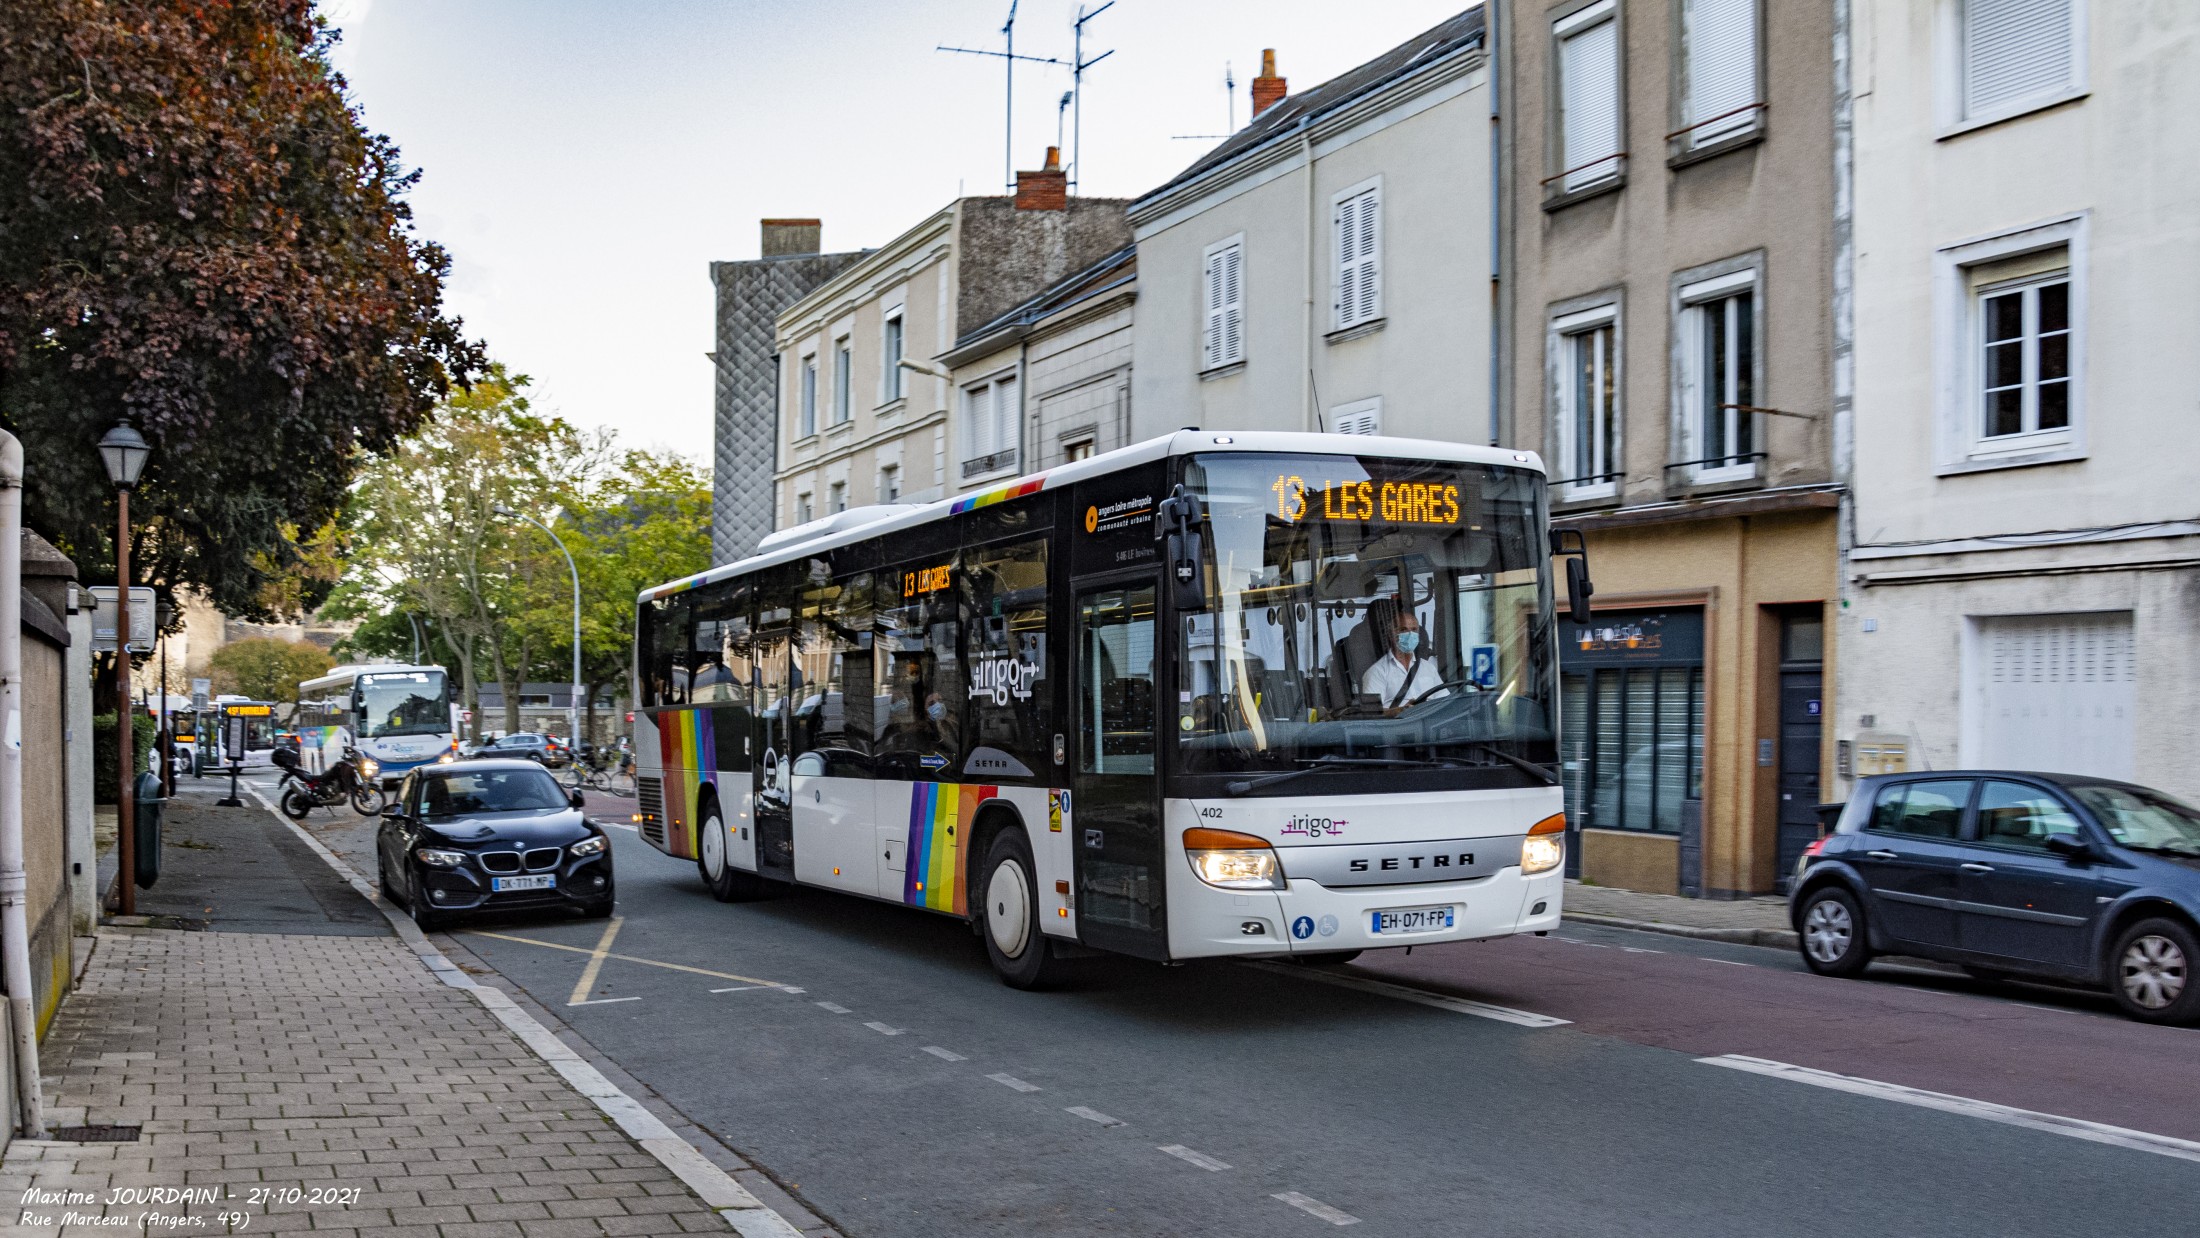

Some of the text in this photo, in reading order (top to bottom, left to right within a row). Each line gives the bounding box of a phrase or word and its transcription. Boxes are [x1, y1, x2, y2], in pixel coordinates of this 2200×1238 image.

[1098, 495, 1152, 517] angers loire métropole
[1271, 475, 1459, 524] 13 LES GARES
[903, 572, 915, 597] 13
[978, 650, 1022, 706] irigo
[975, 760, 1007, 768] SETRA
[1201, 807, 1223, 818] 402
[1291, 814, 1333, 838] irigo
[1350, 853, 1474, 872] SETRA
[1381, 910, 1445, 929] EH-071-FP
